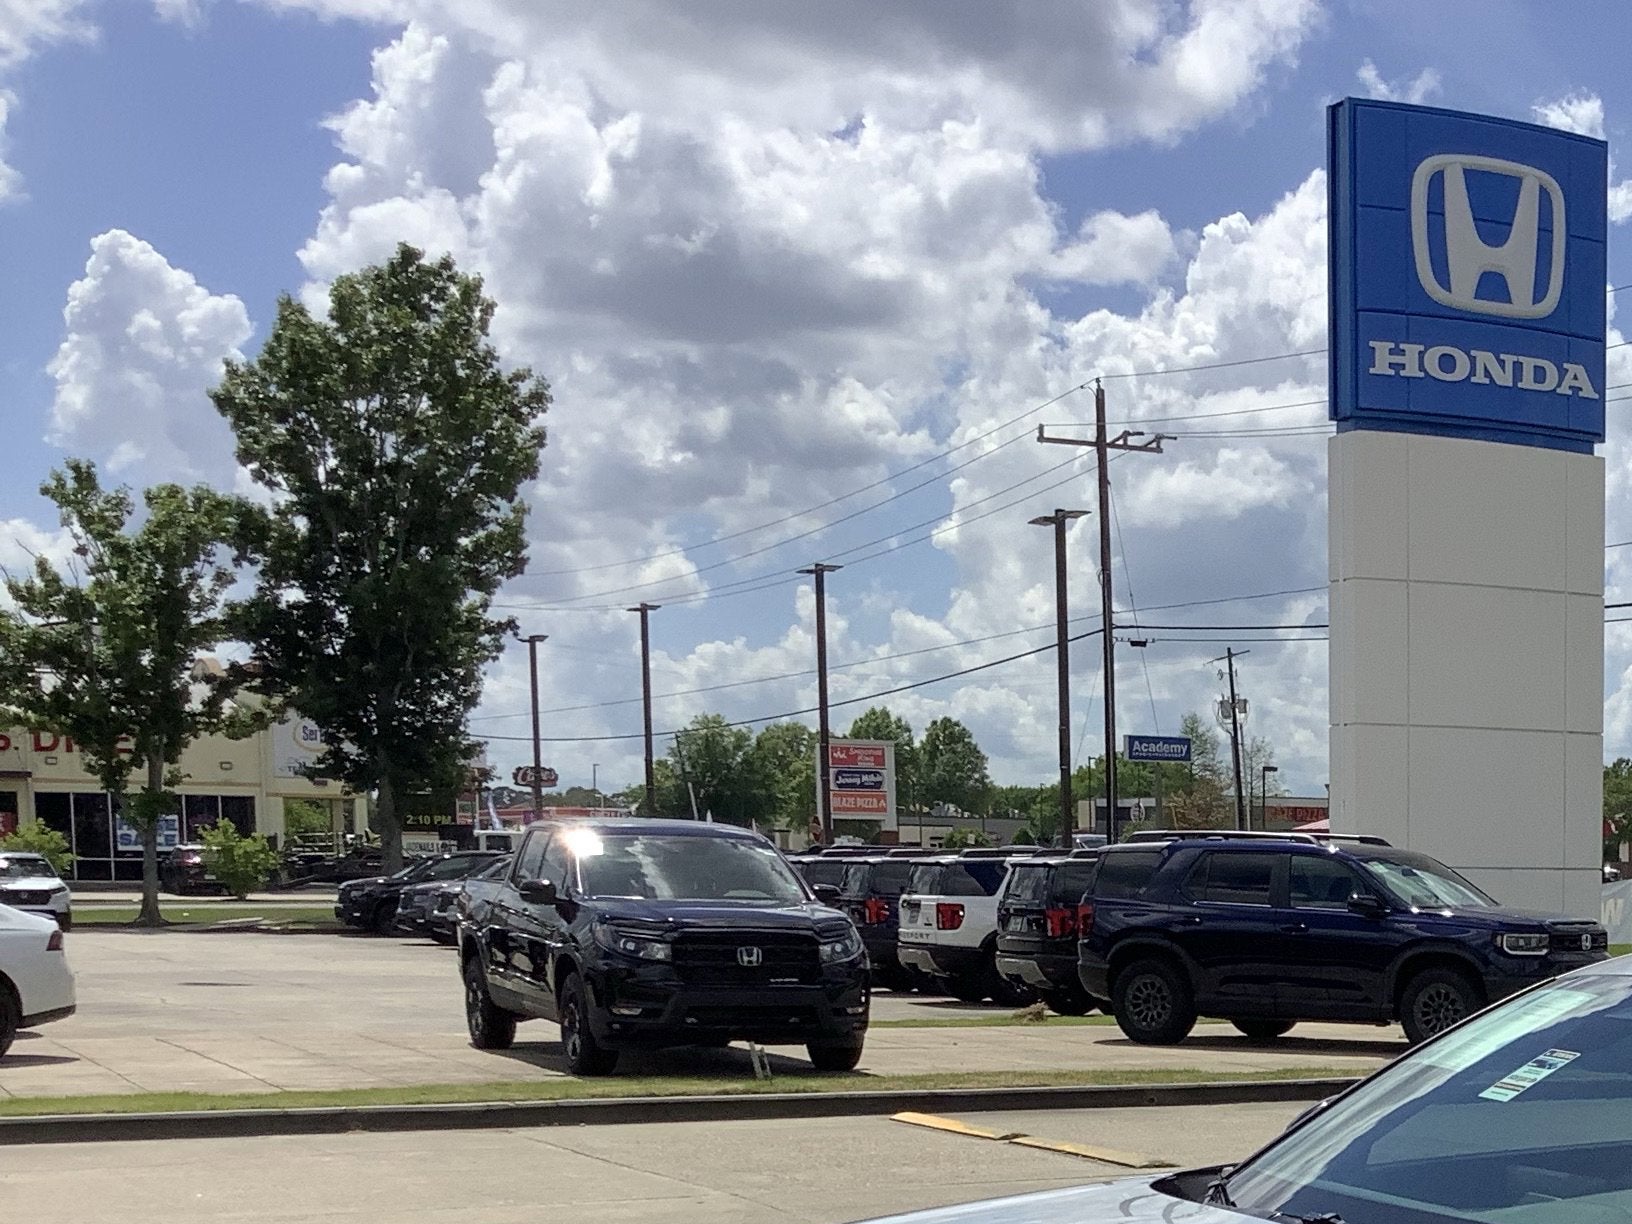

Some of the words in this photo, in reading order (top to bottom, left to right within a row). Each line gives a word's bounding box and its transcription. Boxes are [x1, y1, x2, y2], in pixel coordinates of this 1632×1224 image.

[1369, 341, 1599, 400] HONDA
[1133, 740, 1188, 757] Academy
[406, 815, 431, 825] 2:10
[433, 815, 452, 825] PM
